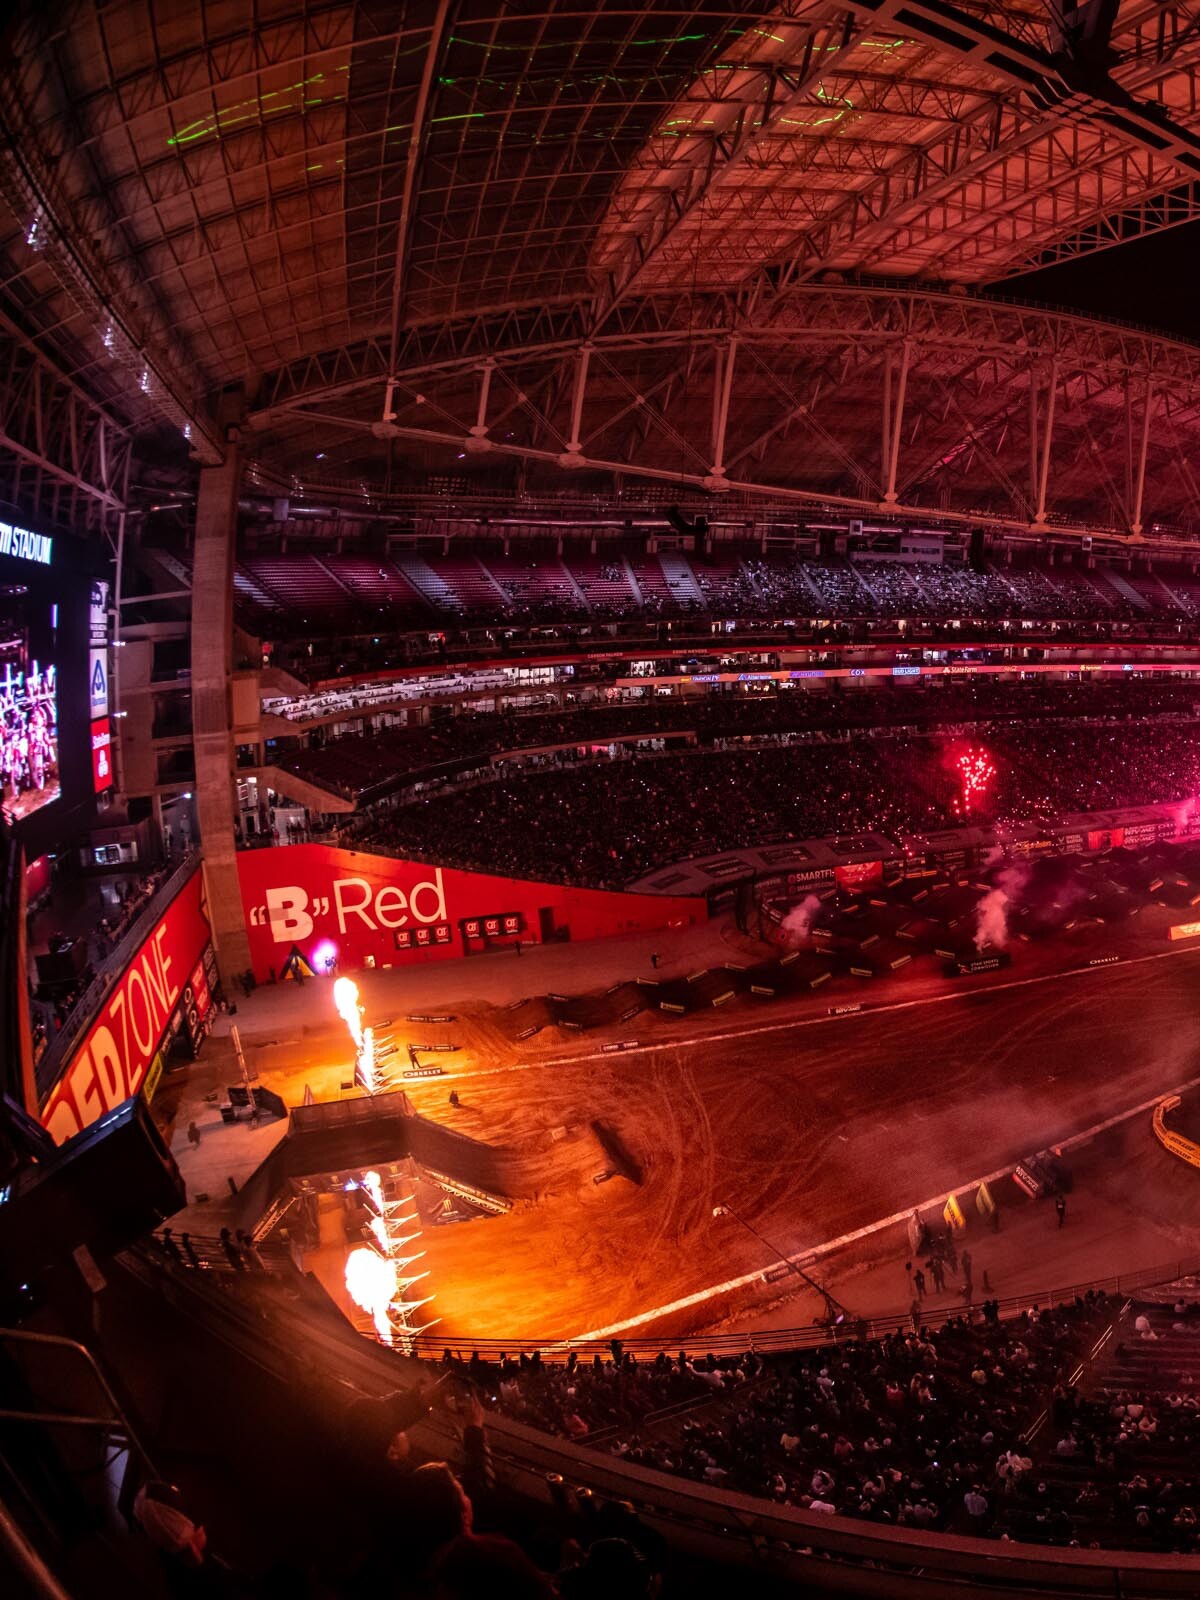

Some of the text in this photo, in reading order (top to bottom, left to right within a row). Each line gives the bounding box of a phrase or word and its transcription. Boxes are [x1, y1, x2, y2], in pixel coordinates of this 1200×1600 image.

[12, 527, 52, 565] STADIUM
[1170, 1136, 1195, 1151] DUNLOP
[1169, 1145, 1191, 1160] DUNLOP
